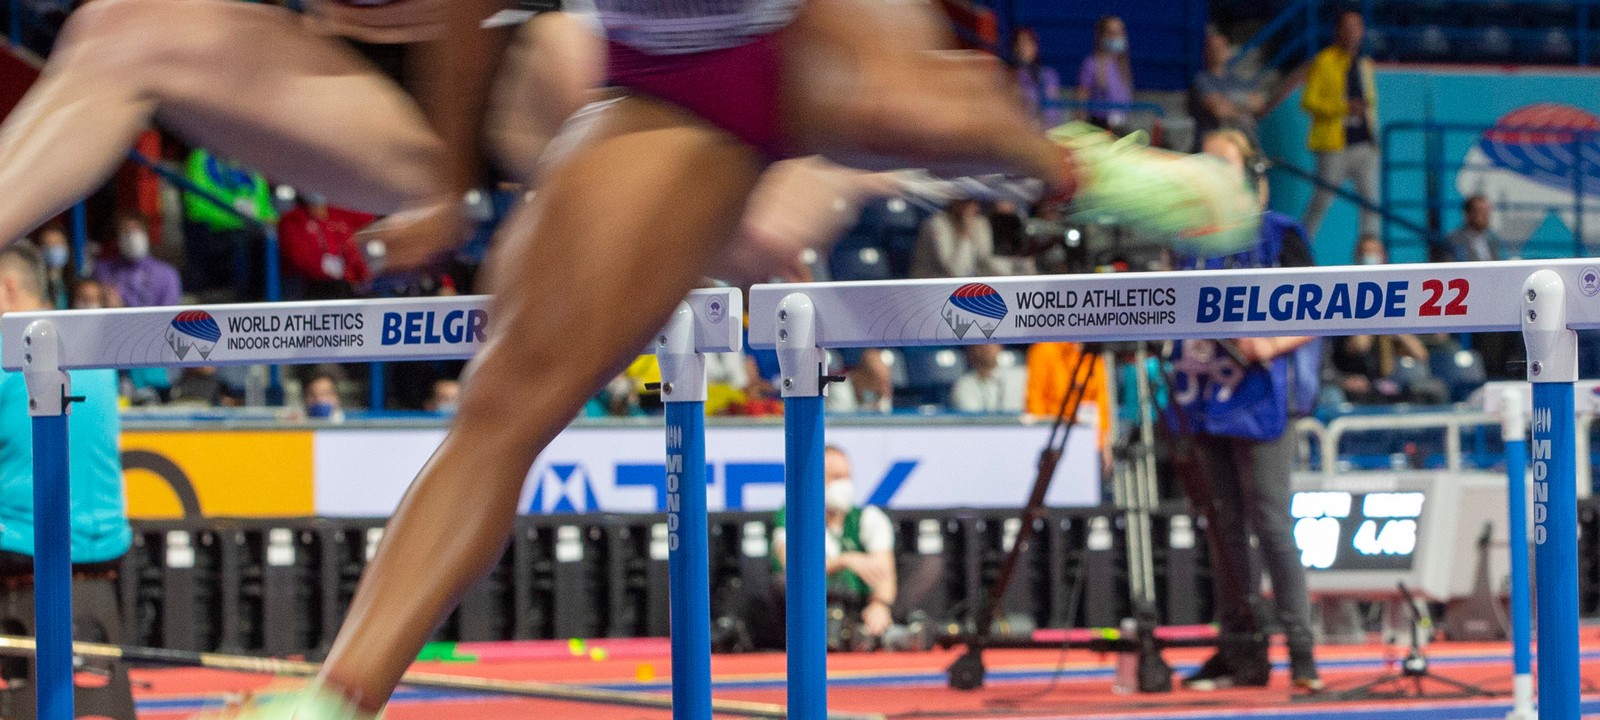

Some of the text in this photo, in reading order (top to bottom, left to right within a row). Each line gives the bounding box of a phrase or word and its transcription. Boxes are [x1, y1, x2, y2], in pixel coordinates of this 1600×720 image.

[1016, 287, 1176, 309] WORLD ATHLETICS
[1196, 278, 1470, 323] BELGRADE 22
[228, 313, 364, 333] WORLD ATHLETICS
[1015, 310, 1176, 328] INDOOR CHAMPIONSHIPS
[227, 334, 364, 350] INDOOR CHAMPIONSHIPS
[666, 454, 682, 551] MONDO
[1533, 439, 1552, 545] MONDO
